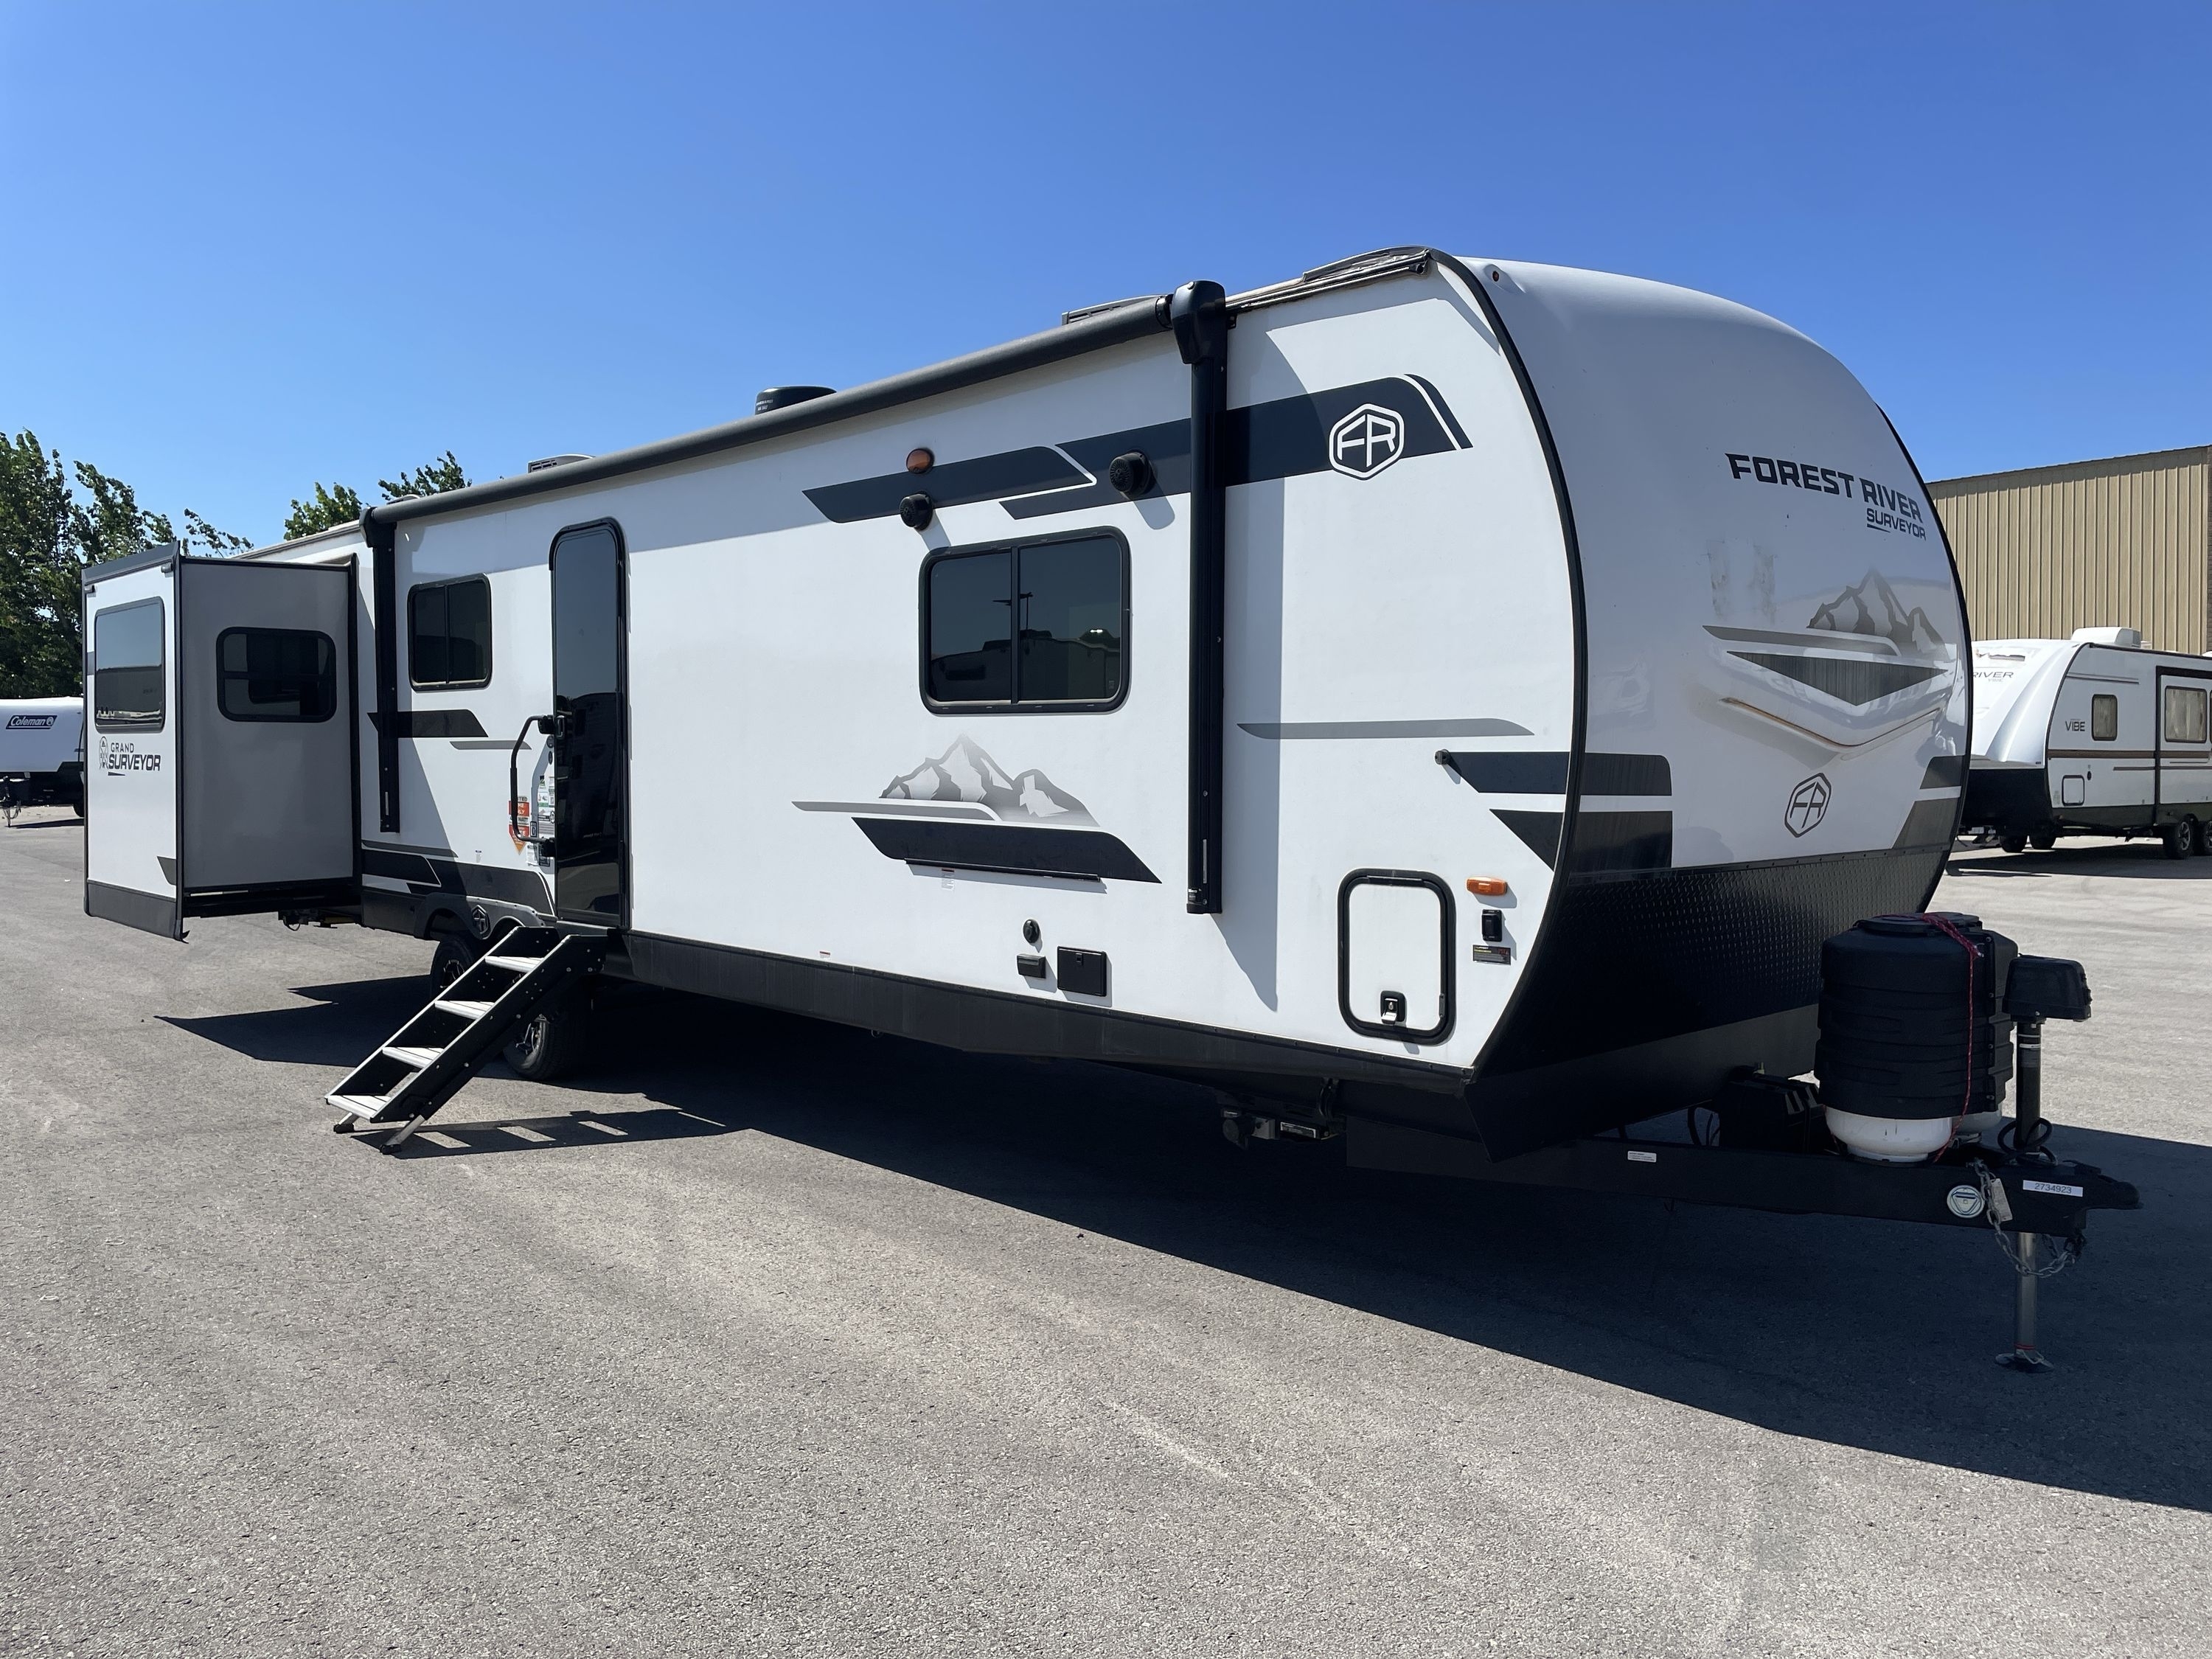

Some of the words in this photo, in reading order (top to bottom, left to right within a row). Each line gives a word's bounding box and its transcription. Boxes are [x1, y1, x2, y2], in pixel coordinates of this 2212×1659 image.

[1724, 452, 1855, 499] FOREST
[1859, 476, 1924, 524] RIVER
[1865, 507, 1927, 541] SURVEYOR
[10, 715, 46, 726] Coleman
[2065, 720, 2086, 731] VIBE
[111, 742, 135, 754] GRAND
[108, 754, 161, 771] SURVEYOR
[2035, 1182, 2072, 1194] 2734923
